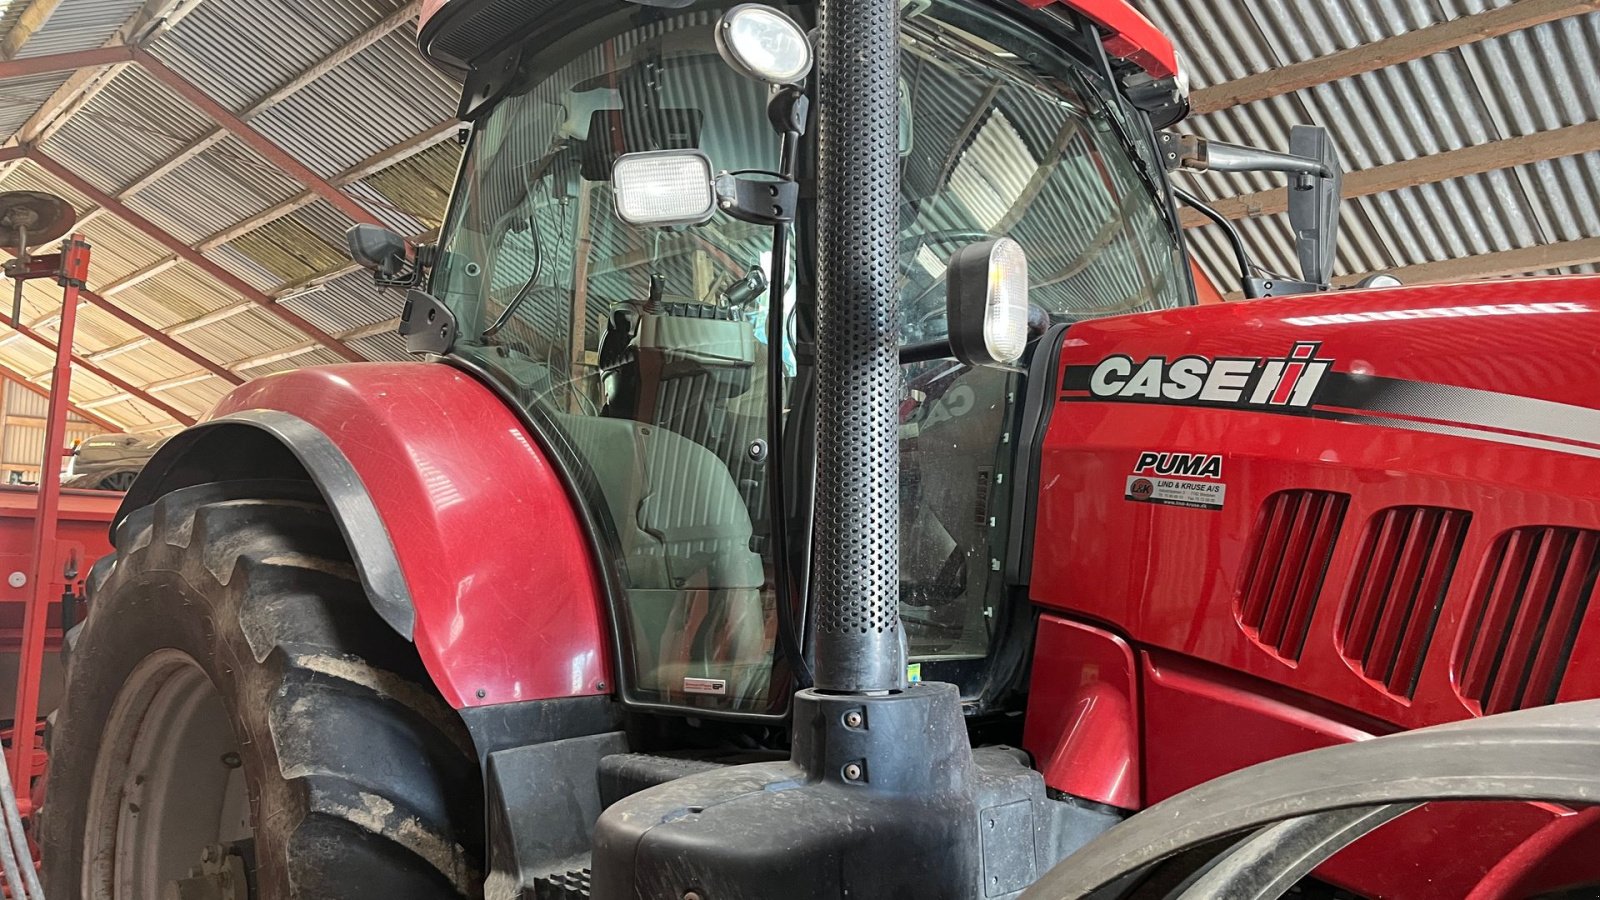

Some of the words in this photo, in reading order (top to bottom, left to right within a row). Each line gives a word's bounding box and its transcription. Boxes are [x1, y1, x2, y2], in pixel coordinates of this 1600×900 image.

[1090, 356, 1255, 402] CASE
[1249, 343, 1328, 407] IH
[1134, 451, 1222, 478] PUMA
[1132, 483, 1151, 494] L&K
[1157, 480, 1174, 488] LIND
[1174, 481, 1180, 489] &
[1181, 482, 1206, 492] KRUSE
[1206, 485, 1220, 493] A/S
